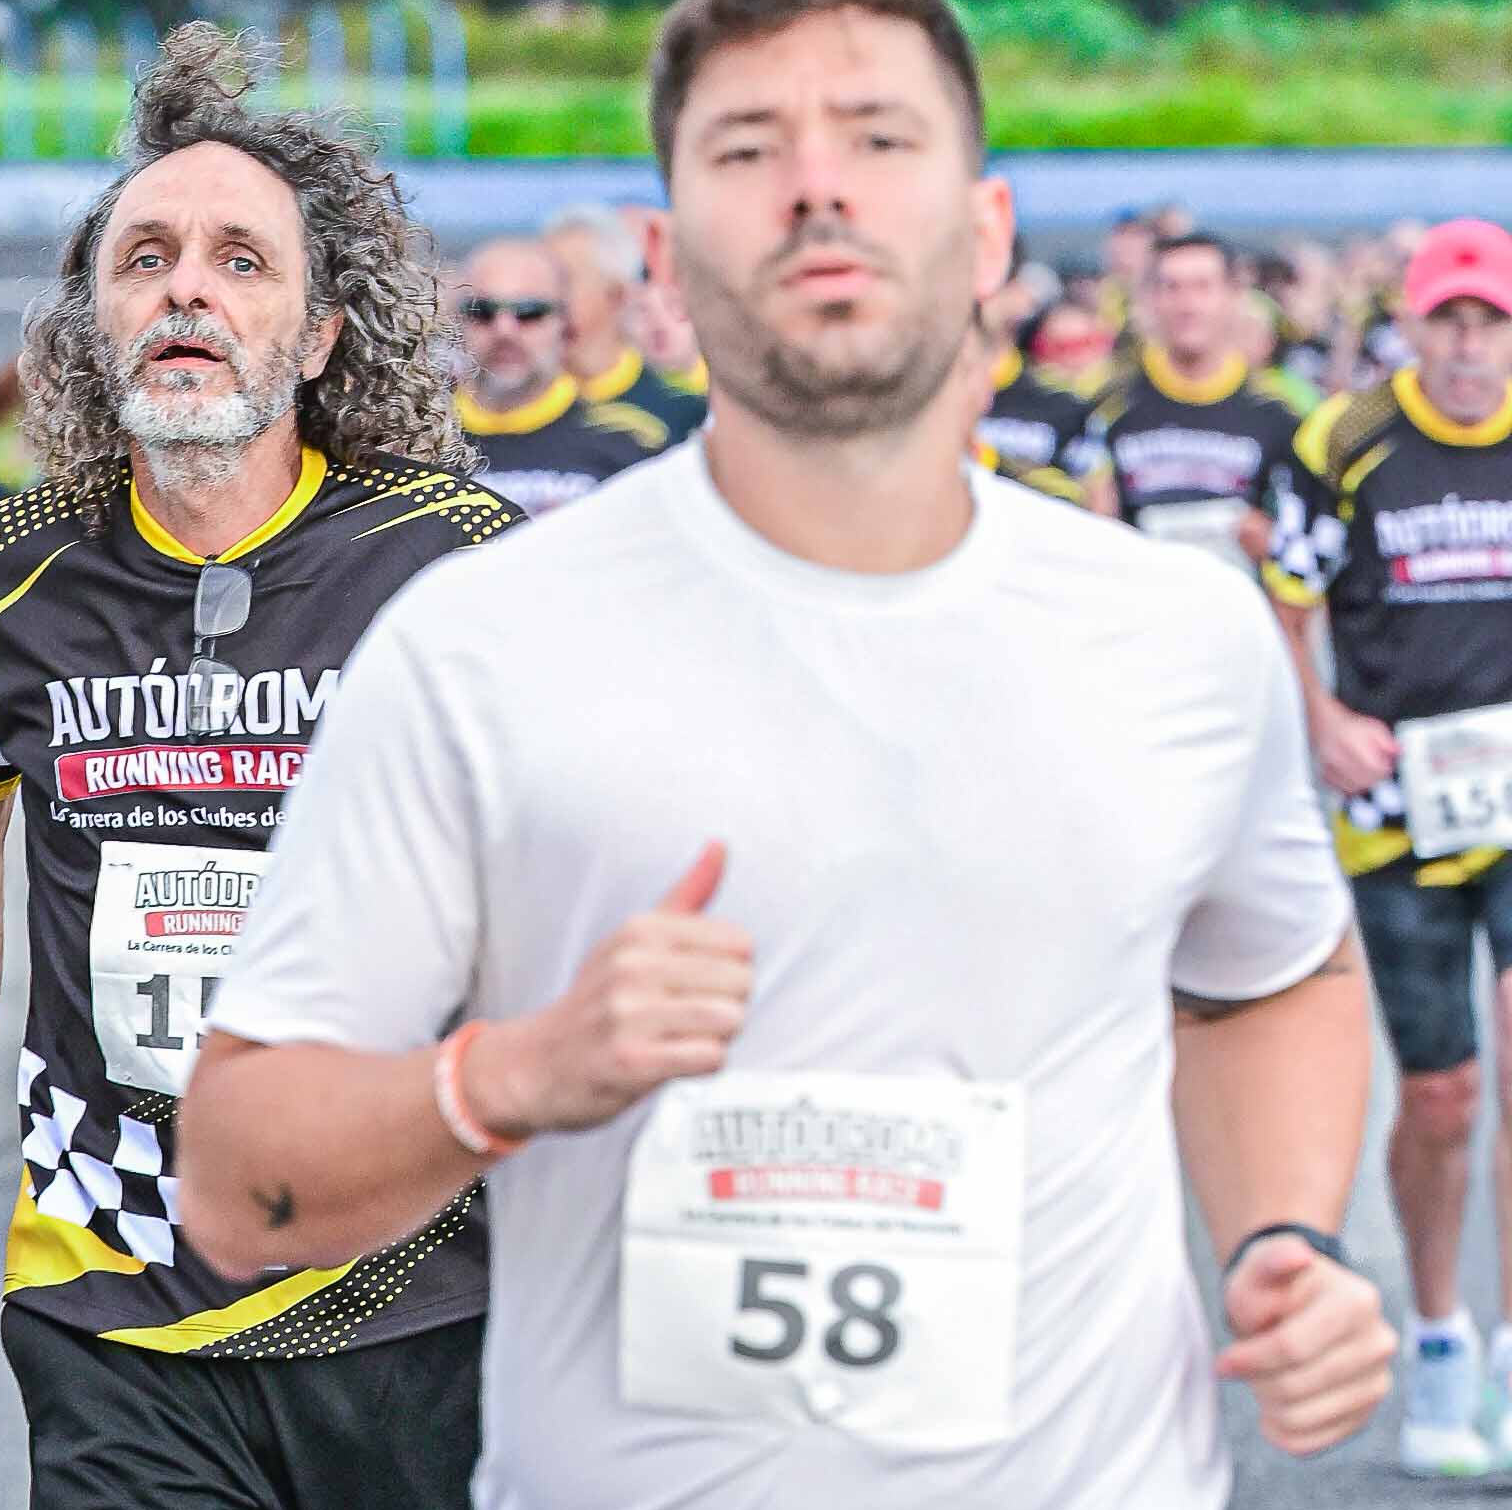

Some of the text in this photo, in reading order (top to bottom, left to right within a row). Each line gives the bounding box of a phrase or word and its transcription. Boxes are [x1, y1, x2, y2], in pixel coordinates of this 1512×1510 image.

[85, 750, 224, 793] RUNNING
[127, 805, 154, 828] de
[158, 805, 188, 827] los
[190, 807, 258, 828] Clubes
[163, 912, 243, 933] RUNNING
[128, 940, 139, 950] La
[143, 941, 182, 953] Carrera
[186, 943, 199, 954] de
[202, 944, 218, 955] los
[728, 1257, 904, 1368] 58
